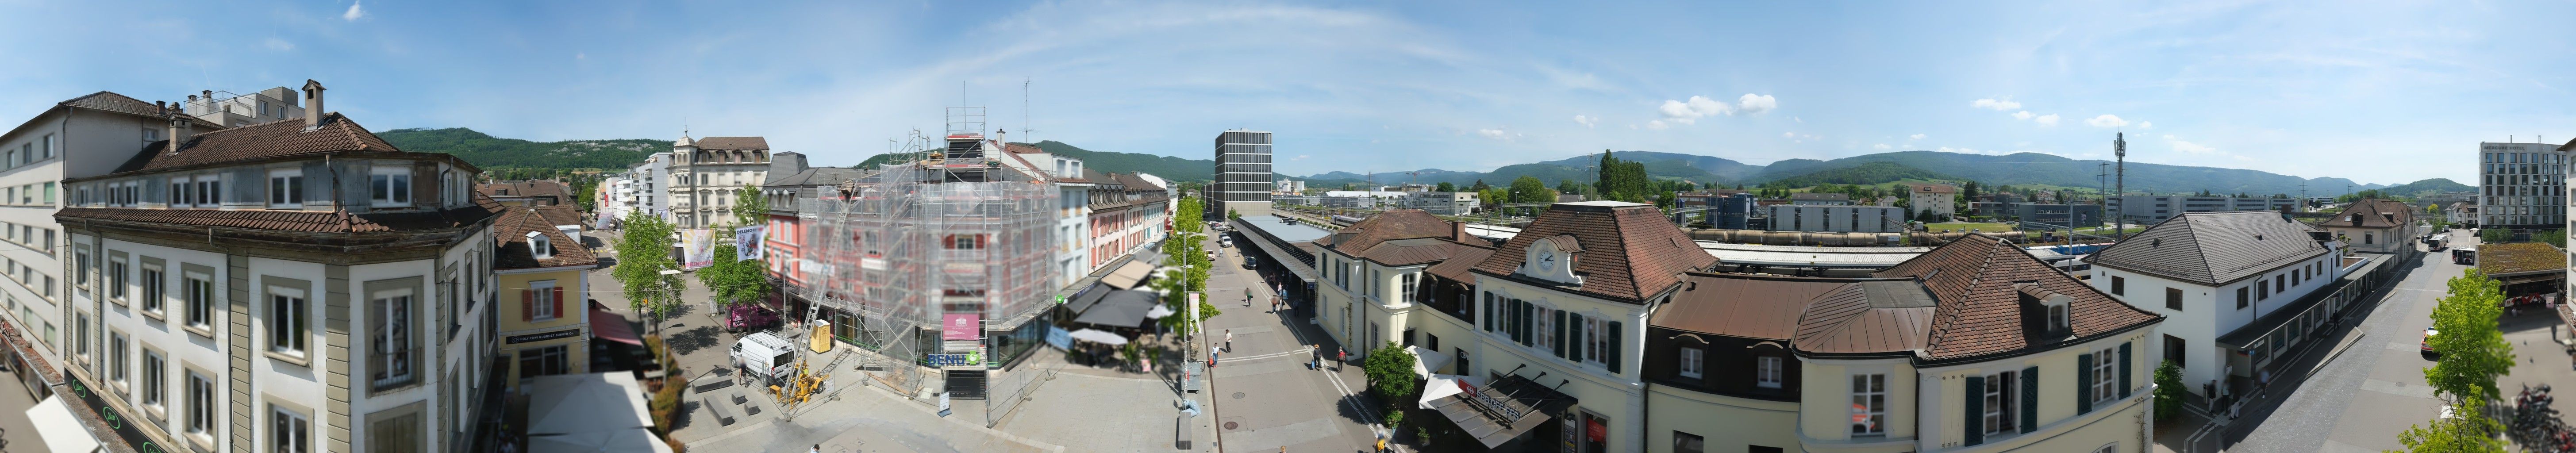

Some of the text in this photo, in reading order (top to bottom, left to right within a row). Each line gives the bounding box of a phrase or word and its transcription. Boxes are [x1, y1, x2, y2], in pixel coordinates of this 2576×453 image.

[928, 353, 965, 366] BENU
[1476, 390, 1520, 422] SBB CFF FFS
